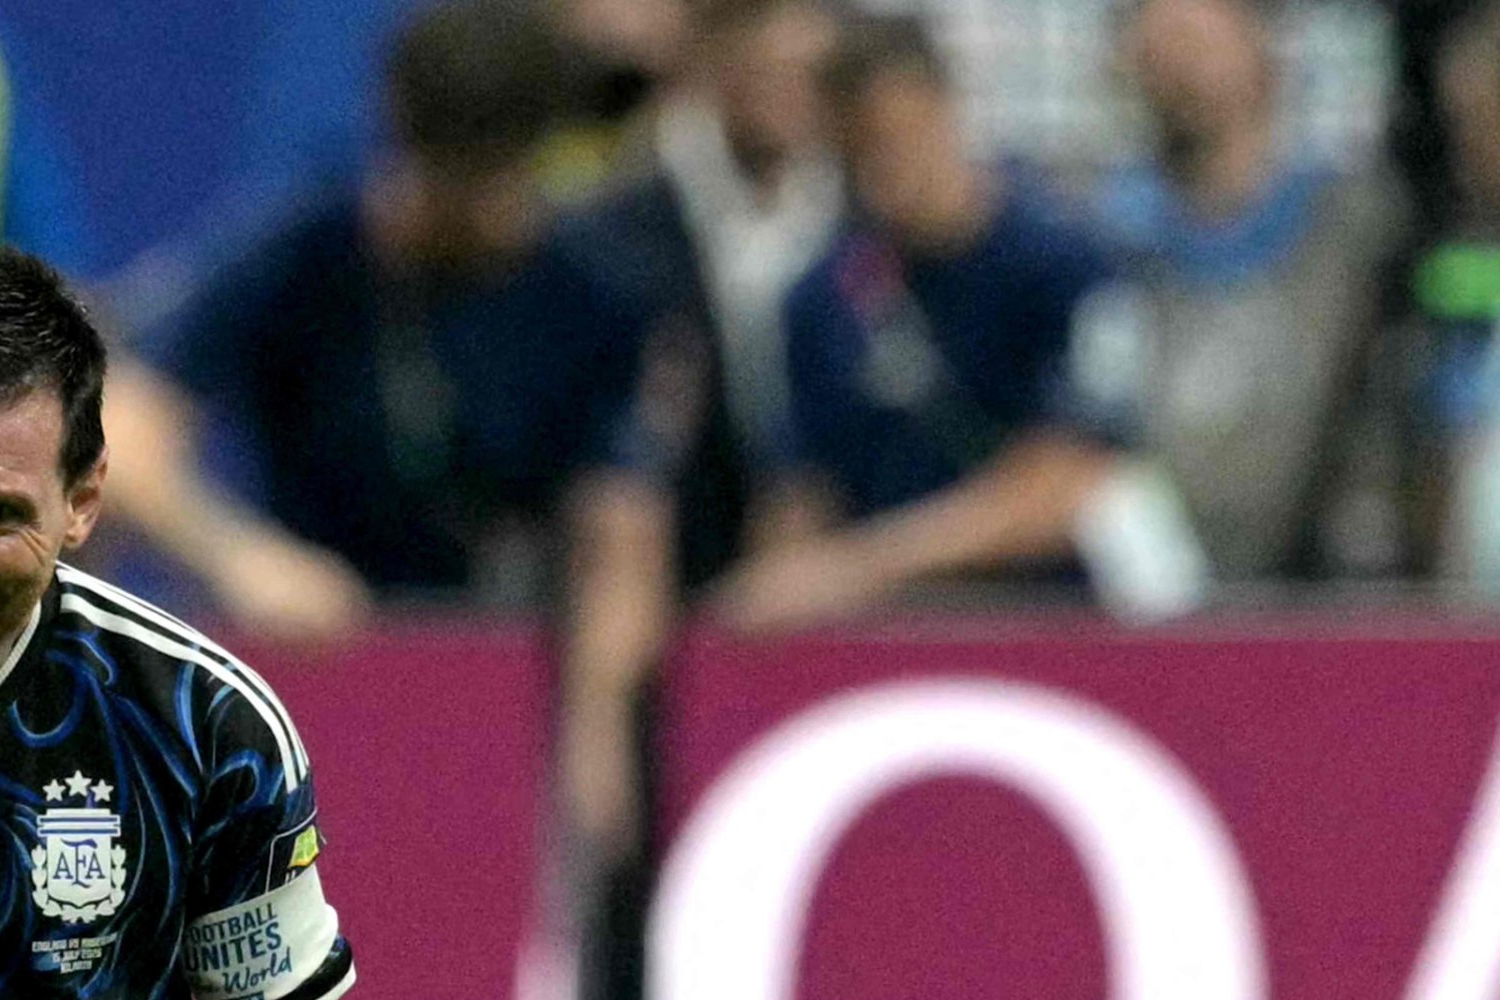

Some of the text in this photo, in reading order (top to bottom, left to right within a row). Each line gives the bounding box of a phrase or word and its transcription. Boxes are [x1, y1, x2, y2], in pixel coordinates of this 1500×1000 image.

[52, 838, 106, 889] AFA
[184, 921, 282, 972] UNITES
[221, 945, 293, 994] World
